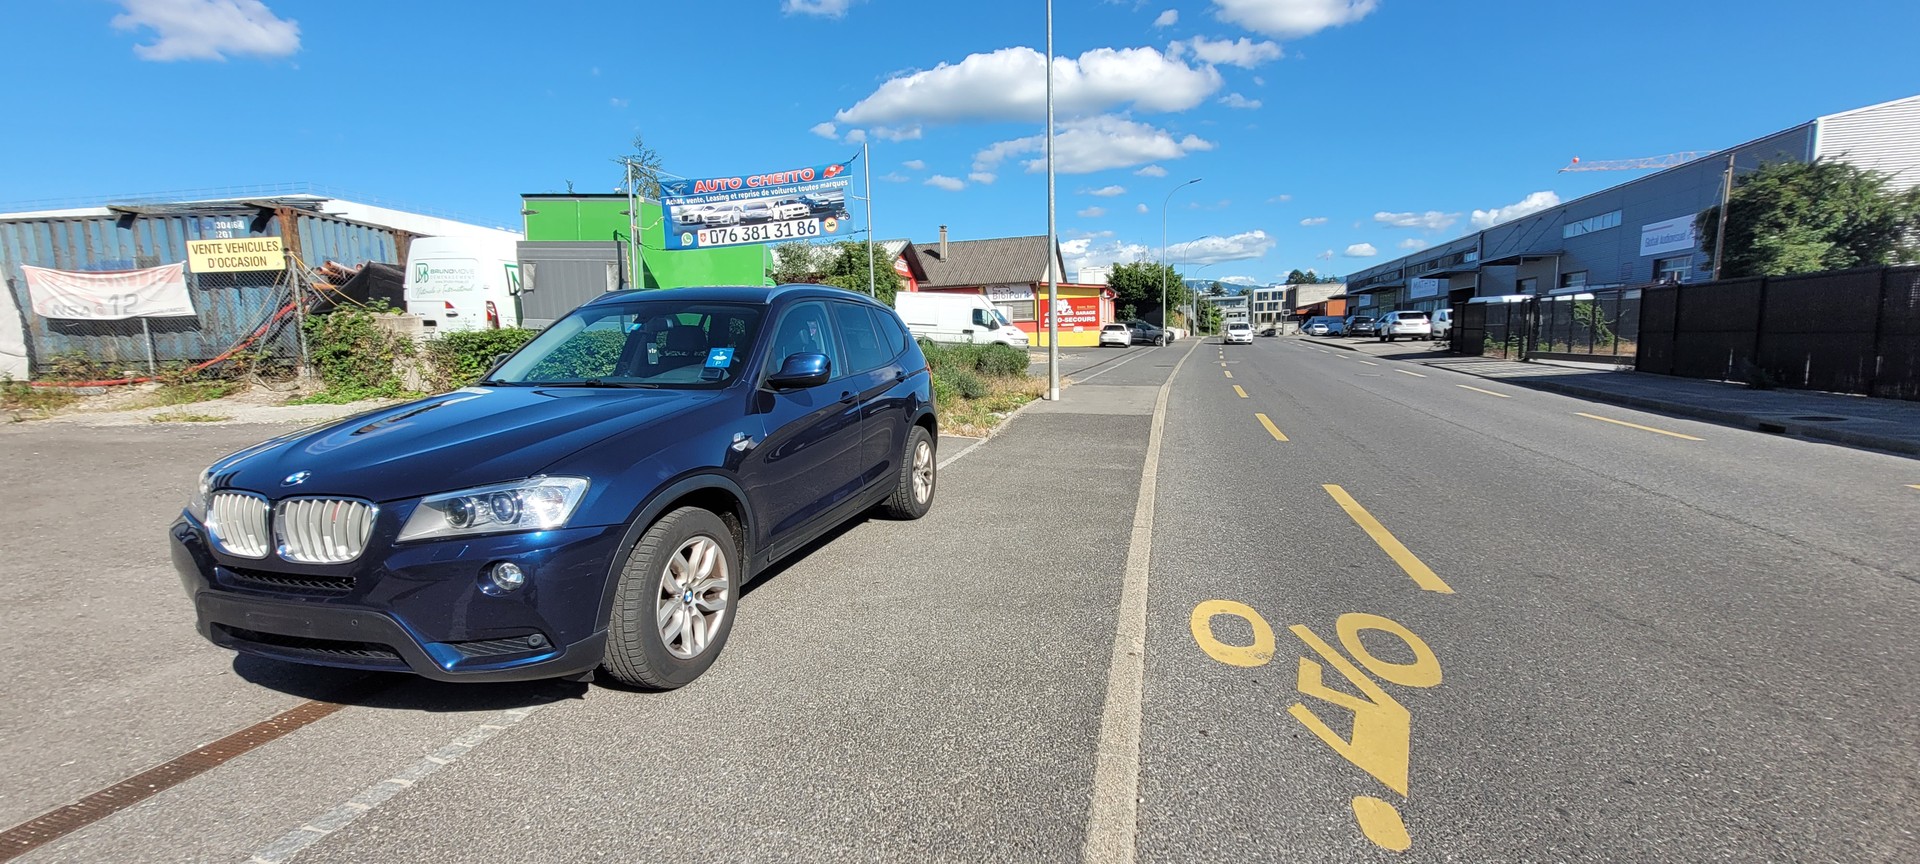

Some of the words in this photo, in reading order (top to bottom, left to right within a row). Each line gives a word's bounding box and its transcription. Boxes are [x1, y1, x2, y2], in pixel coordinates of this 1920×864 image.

[694, 177, 742, 193] AUTO
[746, 168, 815, 187] CHEITO
[666, 198, 685, 206] Achat,
[706, 194, 730, 204] Leasing
[738, 190, 760, 200] reprise
[761, 189, 770, 197] de
[770, 187, 798, 196] voitures
[798, 184, 819, 193] toutes
[820, 180, 849, 191] marques
[710, 228, 738, 244] 076
[741, 225, 771, 242] 381
[774, 222, 793, 238] 31
[797, 220, 816, 235] 86
[192, 243, 223, 255] VENTE
[225, 240, 279, 253] VEHICULES
[207, 256, 267, 268] D'OCCASION
[108, 294, 139, 315] 12
[1044, 316, 1096, 324] AO-SECOURS
